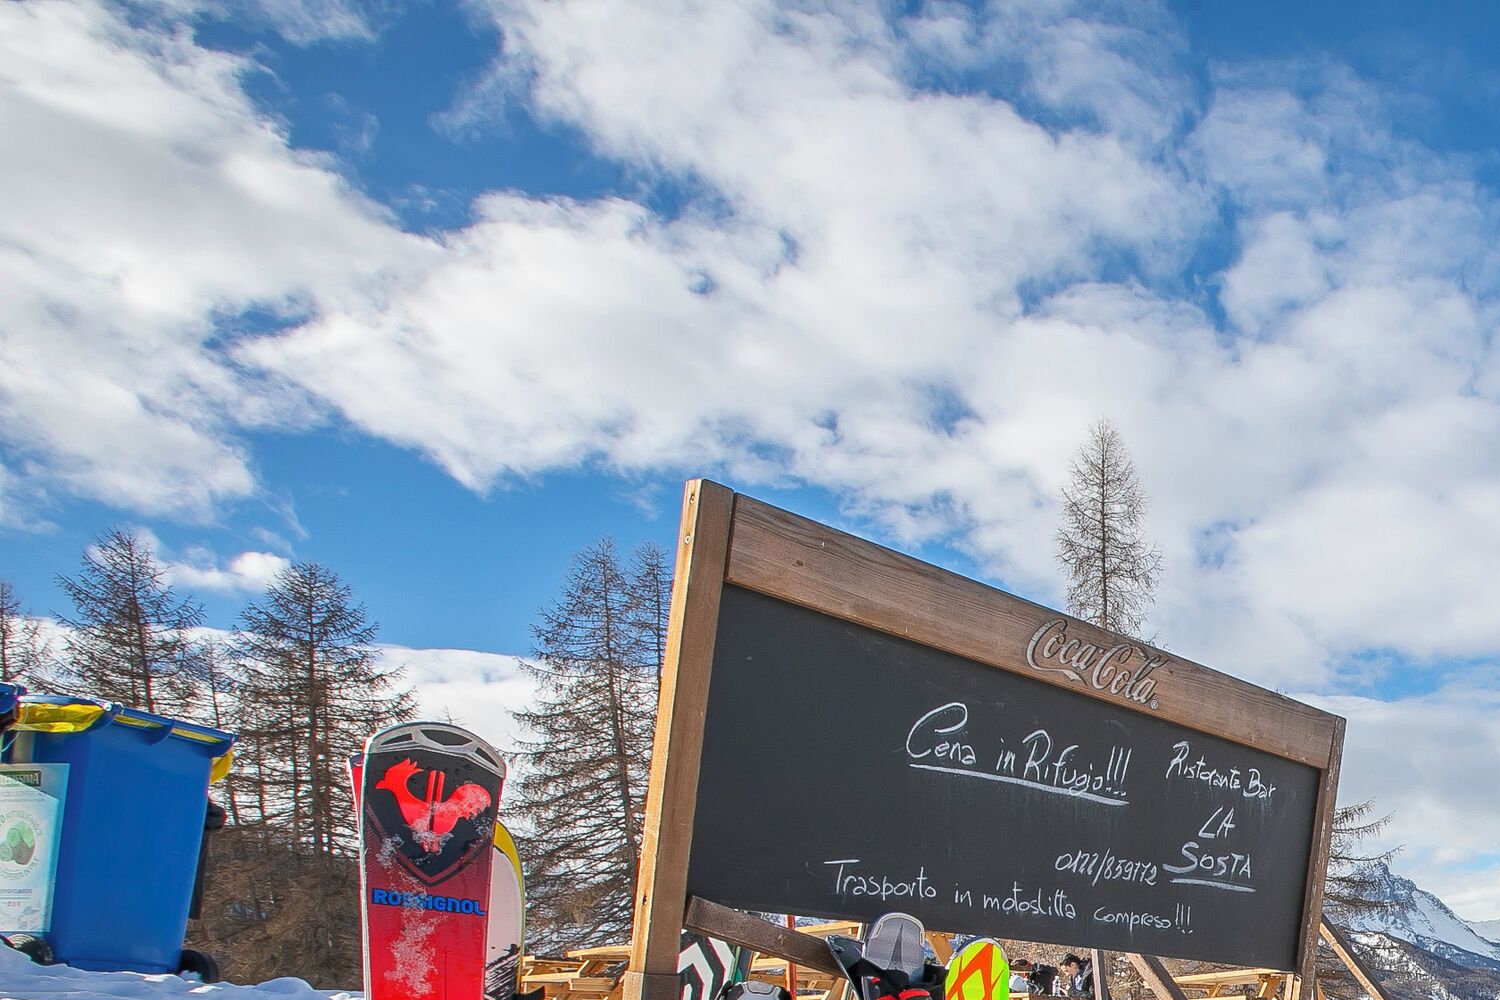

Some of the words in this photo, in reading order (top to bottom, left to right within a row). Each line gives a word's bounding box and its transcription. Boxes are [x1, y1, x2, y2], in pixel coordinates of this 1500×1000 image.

[906, 702, 976, 766] Cena
[996, 738, 1015, 773] in
[1166, 740, 1240, 791] Ristorante
[1243, 768, 1276, 799] Bar
[1198, 805, 1236, 838] LA
[371, 887, 486, 916] ROSSIGNOL
[824, 859, 937, 901] Trasporto
[954, 884, 972, 907] in
[983, 880, 1076, 919] motoslitta
